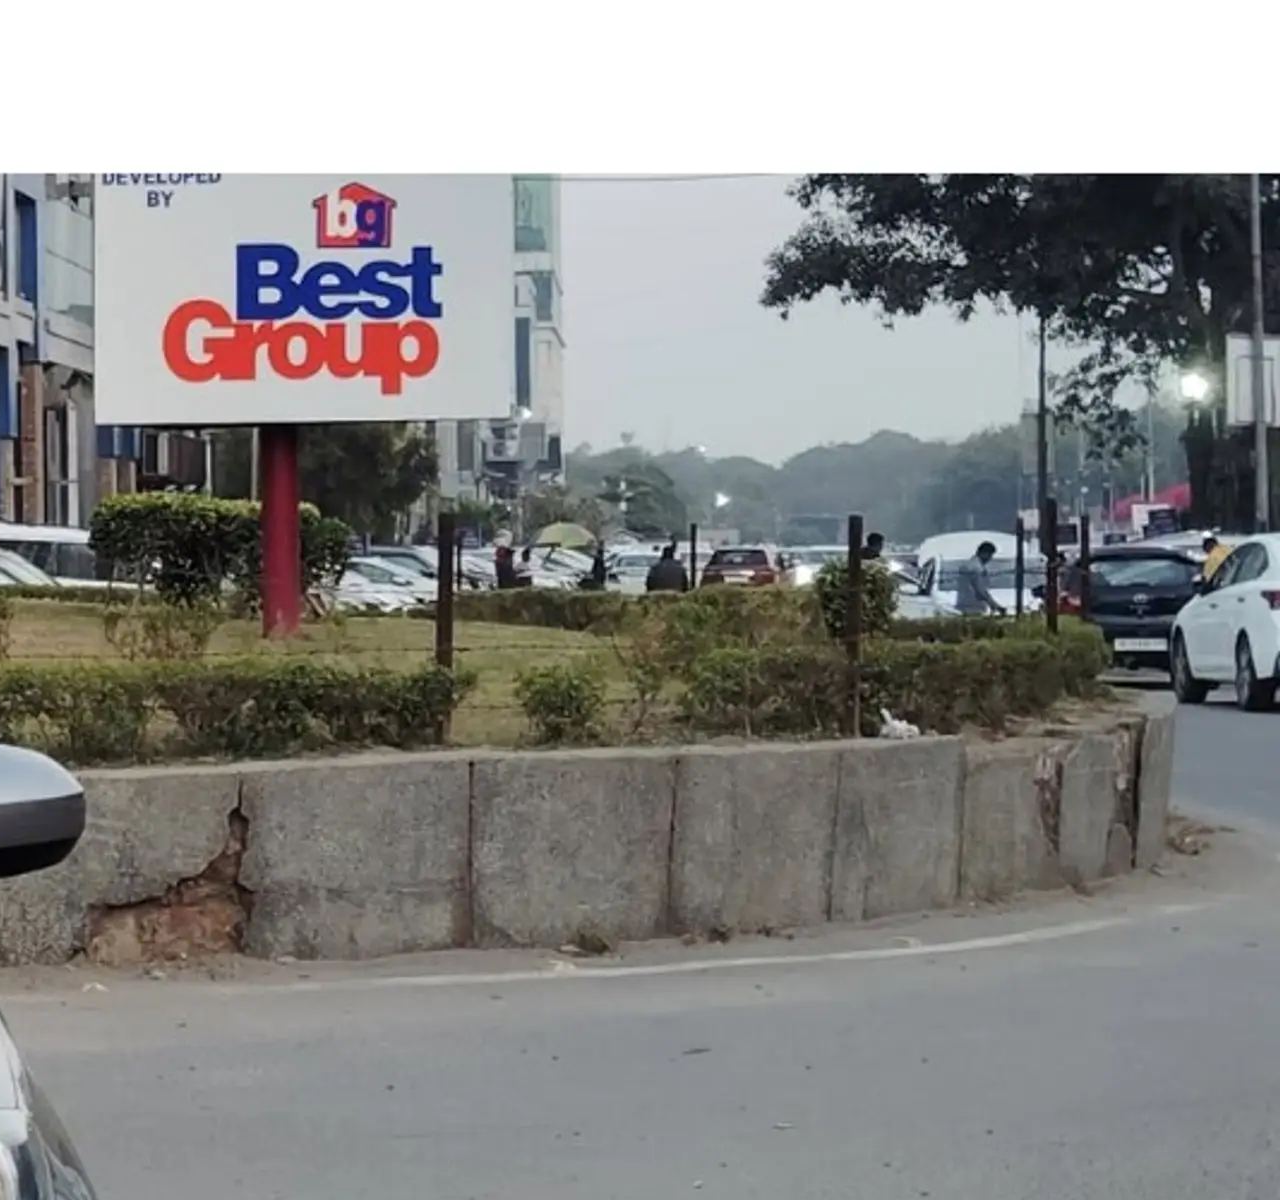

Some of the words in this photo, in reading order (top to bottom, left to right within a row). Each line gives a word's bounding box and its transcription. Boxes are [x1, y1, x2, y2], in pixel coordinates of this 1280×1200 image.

[146, 189, 175, 208] BY
[236, 242, 443, 320] Best
[162, 299, 440, 395] Group
